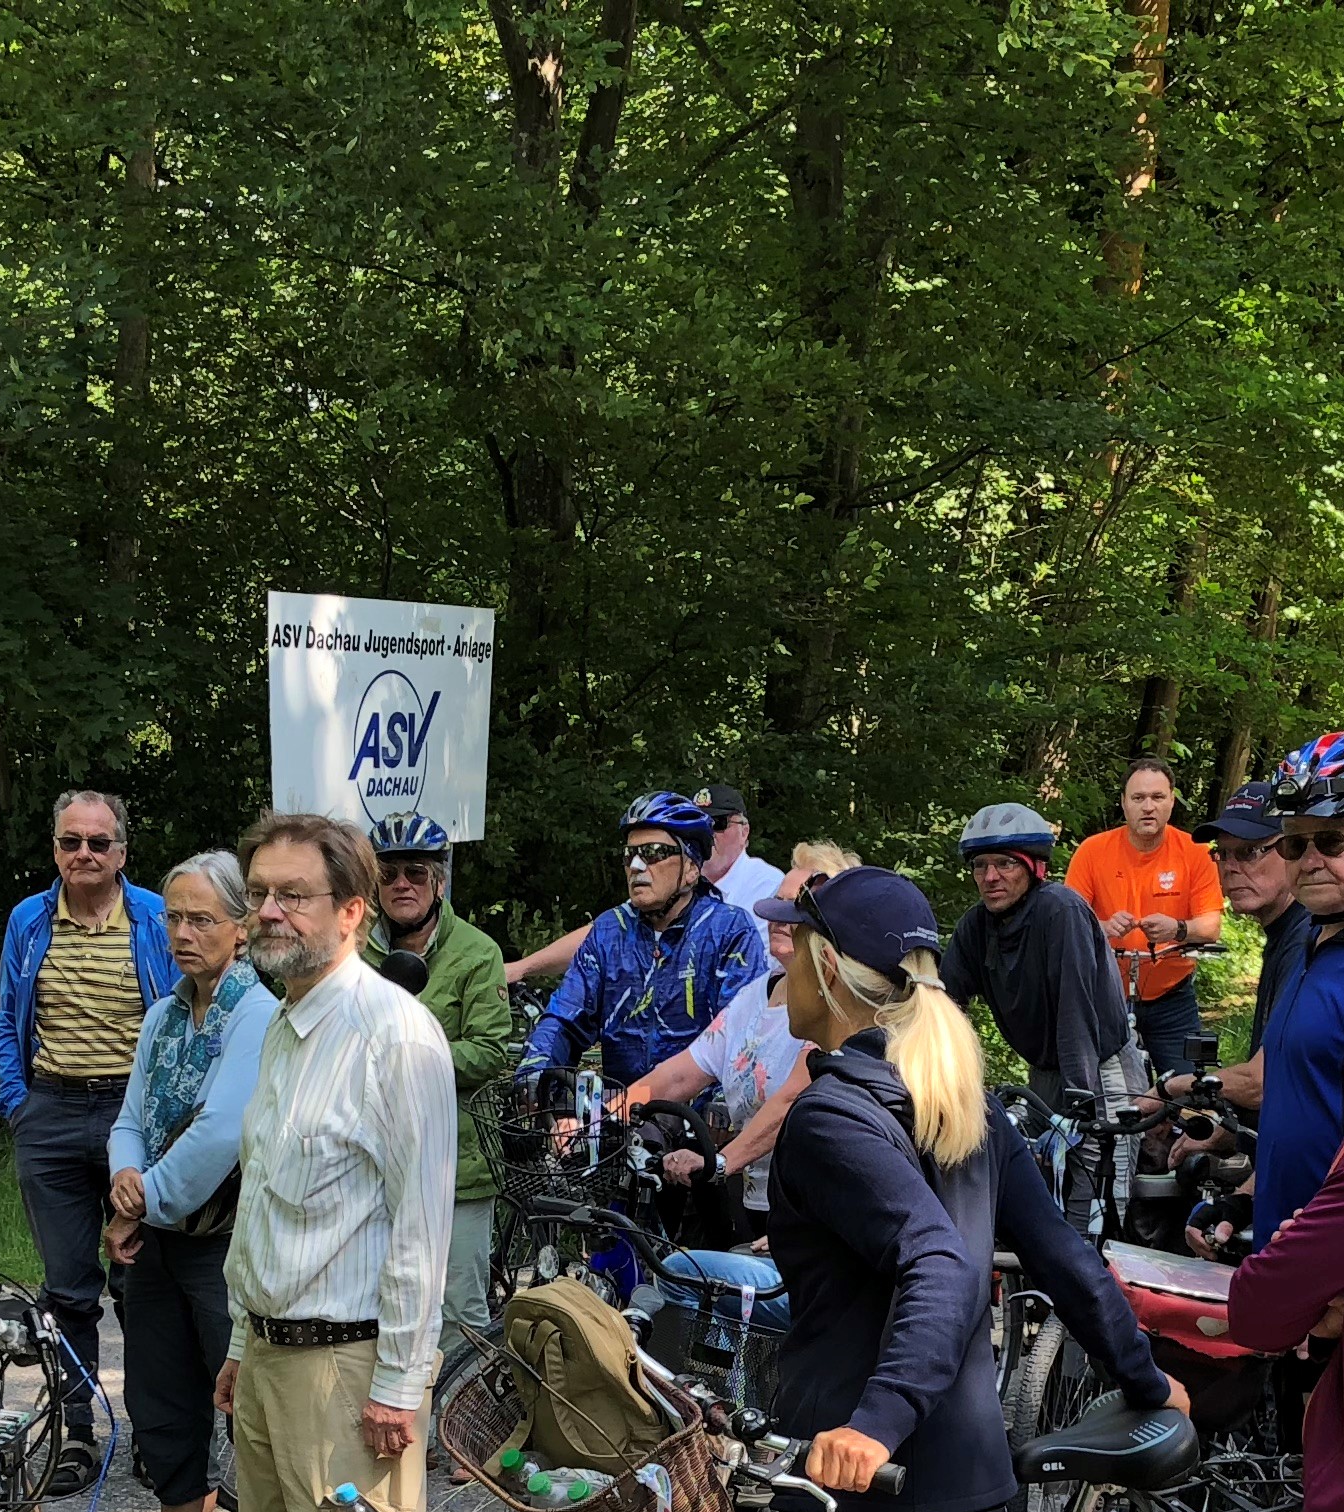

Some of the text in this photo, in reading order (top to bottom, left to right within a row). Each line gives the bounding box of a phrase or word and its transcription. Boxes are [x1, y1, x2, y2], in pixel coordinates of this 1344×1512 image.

[272, 624, 302, 648] ASV
[306, 624, 360, 652] Dachau
[364, 629, 445, 660] Jugendsport
[452, 635, 491, 663] Anlage
[348, 691, 441, 780] ASV
[366, 776, 419, 797] DACHAU
[1043, 1462, 1065, 1471] GEL
